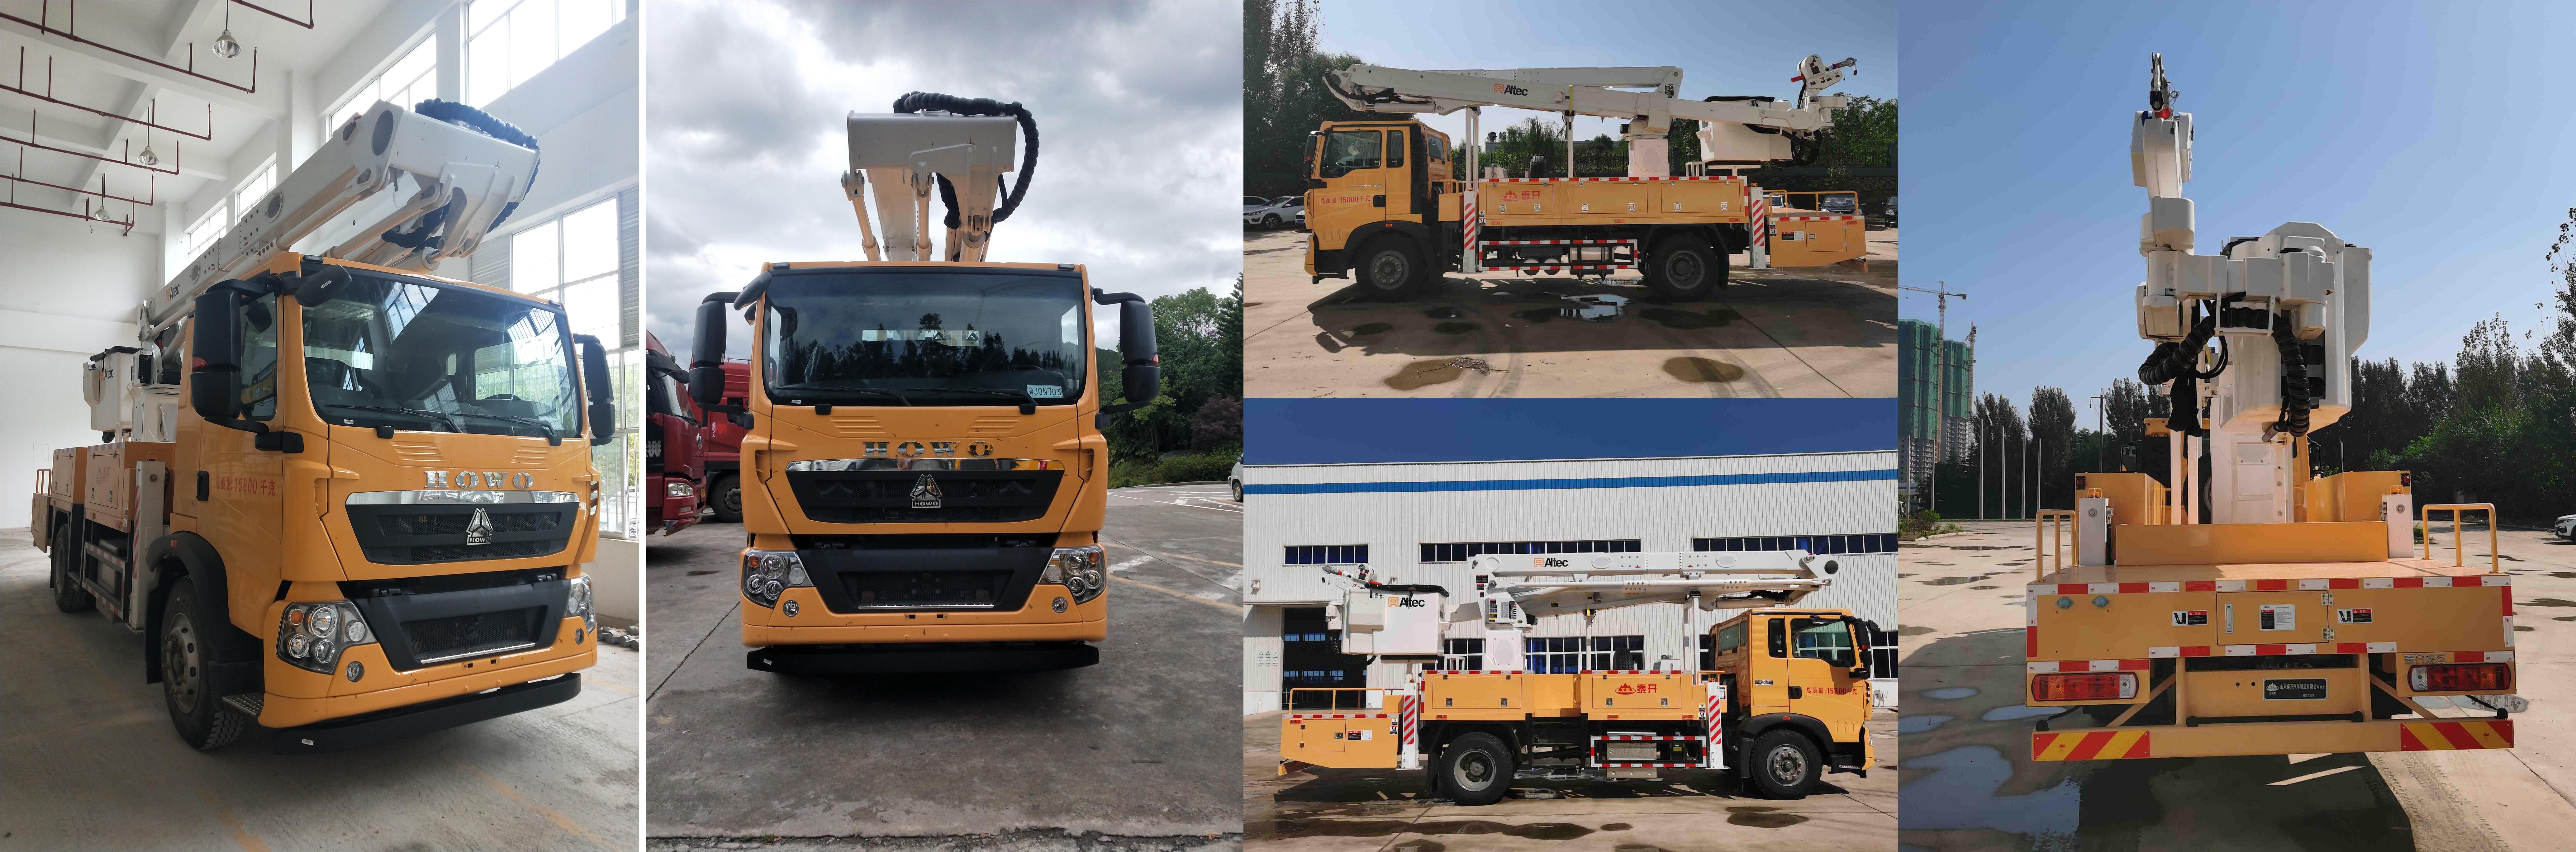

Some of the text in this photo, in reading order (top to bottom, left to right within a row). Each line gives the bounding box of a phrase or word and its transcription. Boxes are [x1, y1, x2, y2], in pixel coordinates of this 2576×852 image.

[1504, 85, 1528, 96] Altec
[170, 284, 180, 301] Altec
[104, 368, 114, 380] Altec
[863, 441, 994, 457] HOWO
[424, 471, 534, 489] HOWO
[1544, 558, 1568, 567] Altec
[1399, 597, 1425, 607] Altec
[1637, 684, 1657, 693] 泰开
